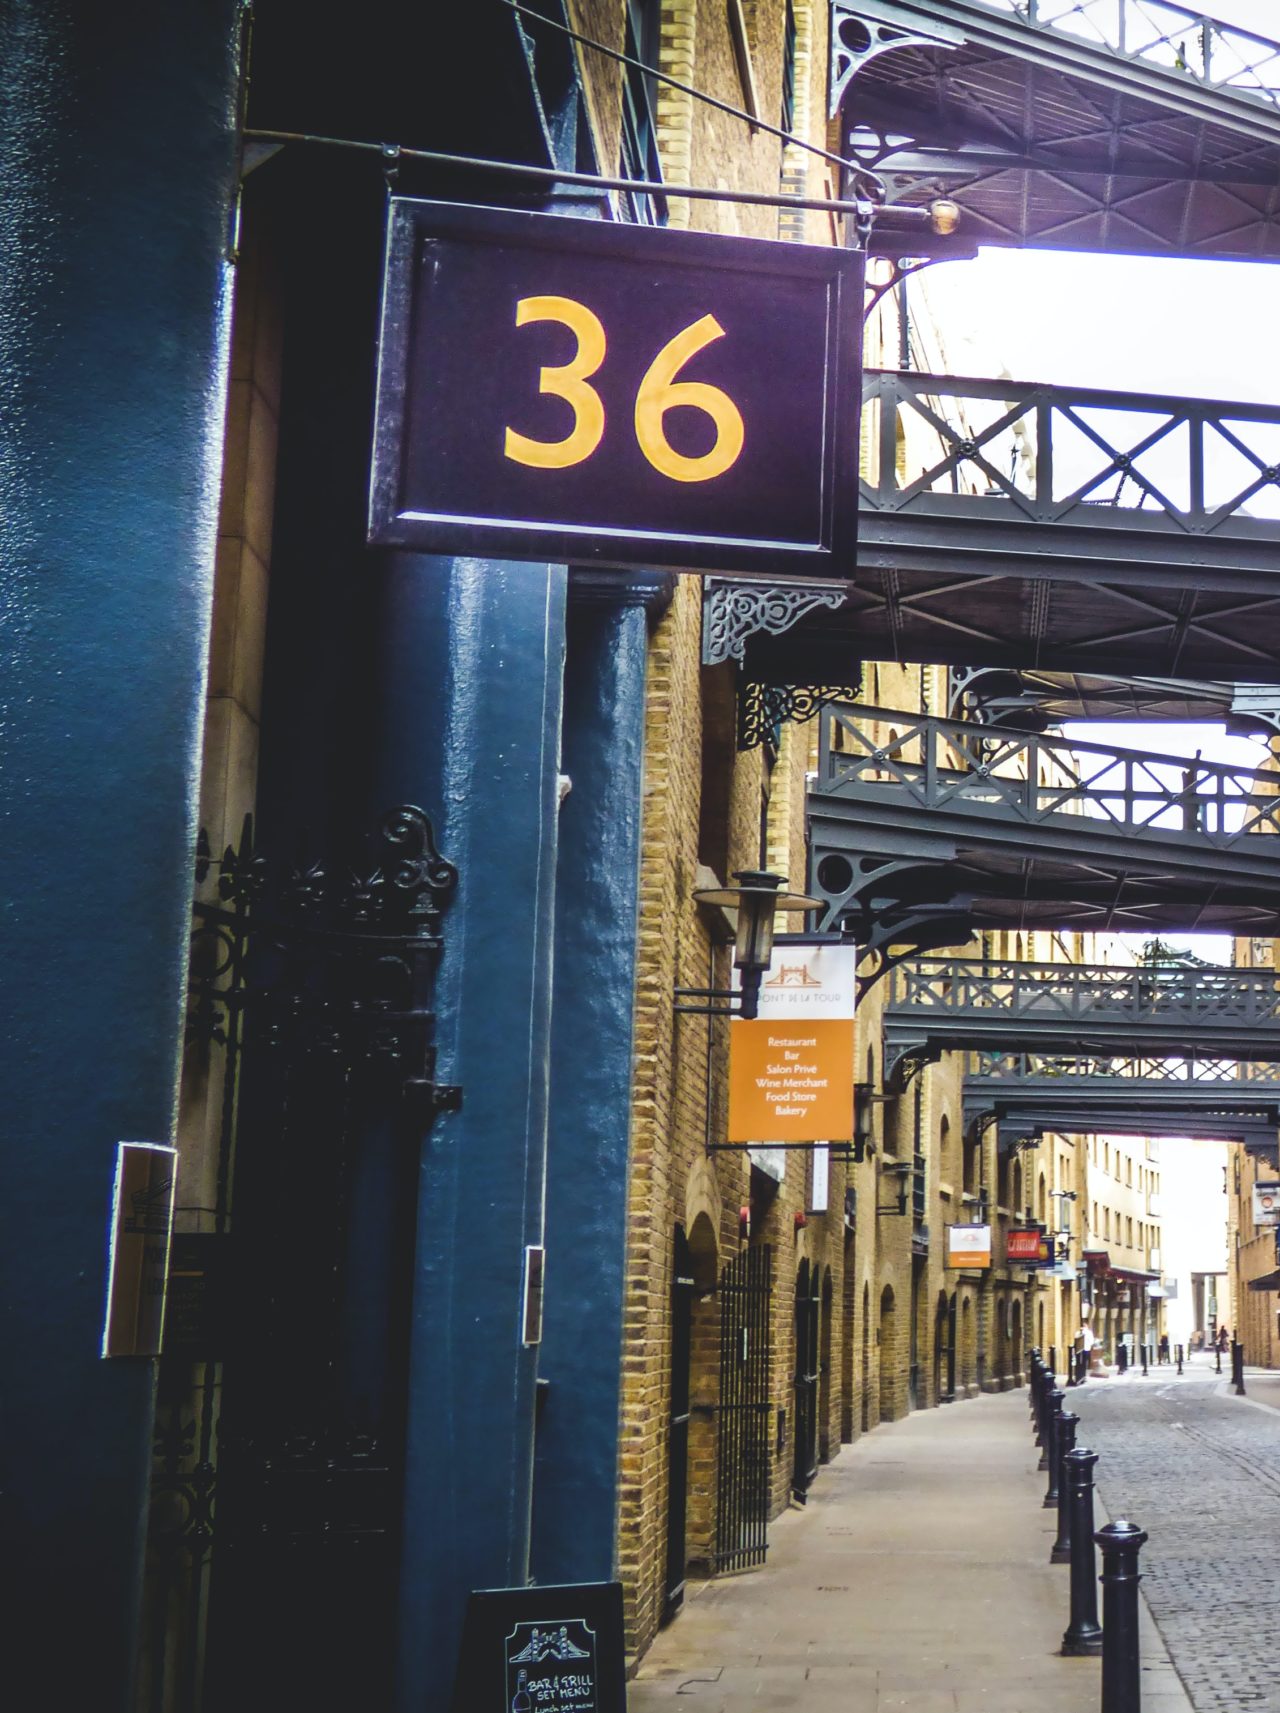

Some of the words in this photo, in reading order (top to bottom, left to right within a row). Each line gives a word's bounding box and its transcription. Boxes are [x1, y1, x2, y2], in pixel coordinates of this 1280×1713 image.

[504, 295, 745, 483] 36
[768, 1037, 817, 1047] Restaurant
[784, 1050, 800, 1061] Bar
[766, 1064, 792, 1075] Salon
[755, 1078, 781, 1088] Wine
[783, 1077, 828, 1088] Merchant
[765, 1091, 790, 1102] Food
[791, 1091, 817, 1102] Store
[775, 1105, 808, 1118] Bakery
[527, 1678, 552, 1692] BAR
[561, 1674, 594, 1688] GRILL
[537, 1689, 556, 1701] SET
[560, 1686, 590, 1698] MENU
